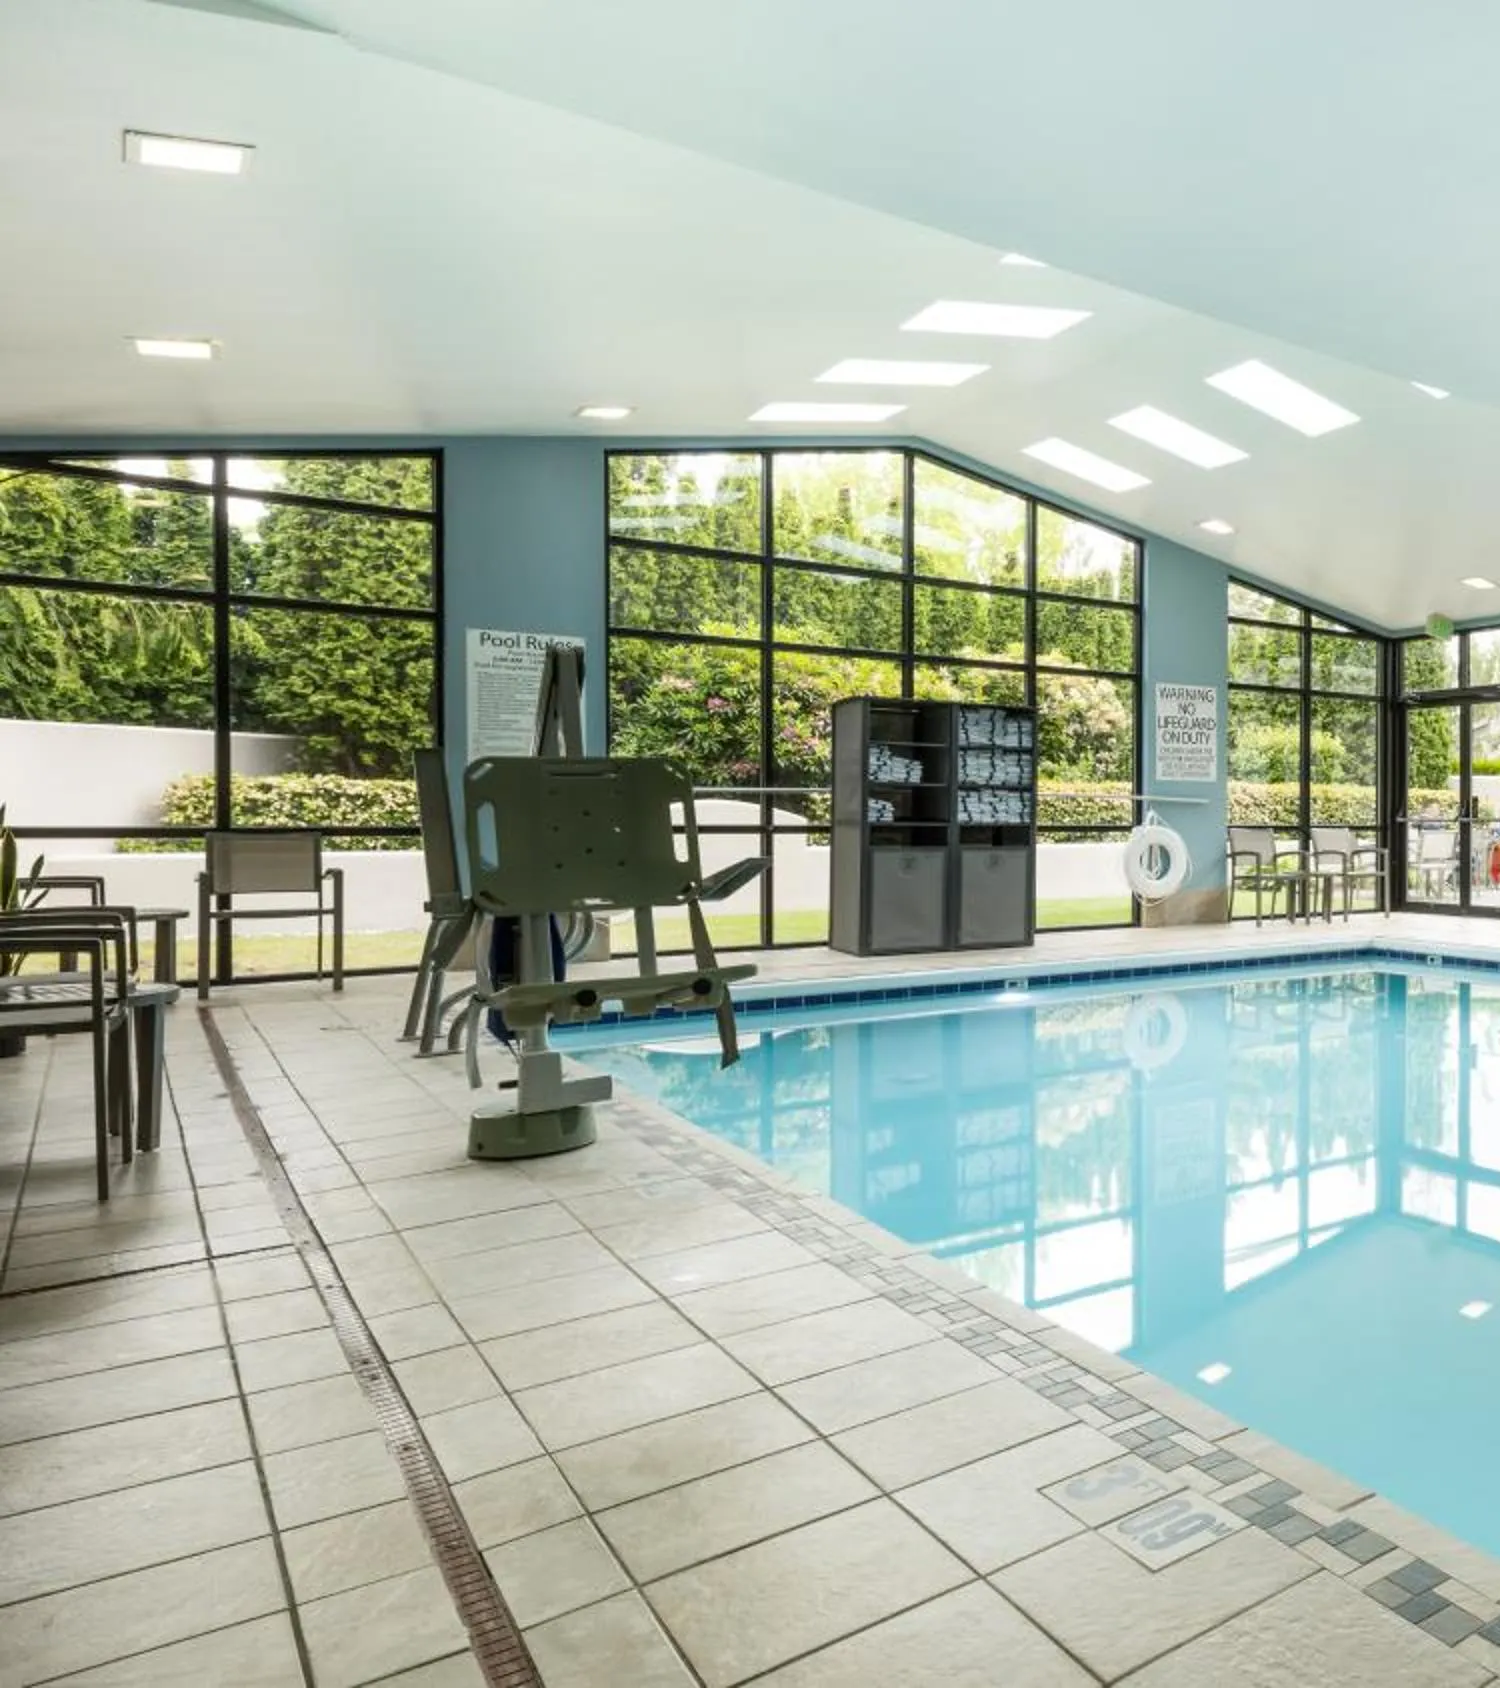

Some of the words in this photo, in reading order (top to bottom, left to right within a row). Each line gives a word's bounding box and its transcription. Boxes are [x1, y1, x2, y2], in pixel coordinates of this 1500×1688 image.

[479, 631, 521, 649] Pool
[1159, 687, 1214, 703] WARNING
[1178, 702, 1196, 716] NO
[1157, 715, 1216, 731] LIFEGUARD
[1162, 730, 1180, 745] ON
[1181, 731, 1210, 745] DUTY
[1065, 1465, 1140, 1500] 3
